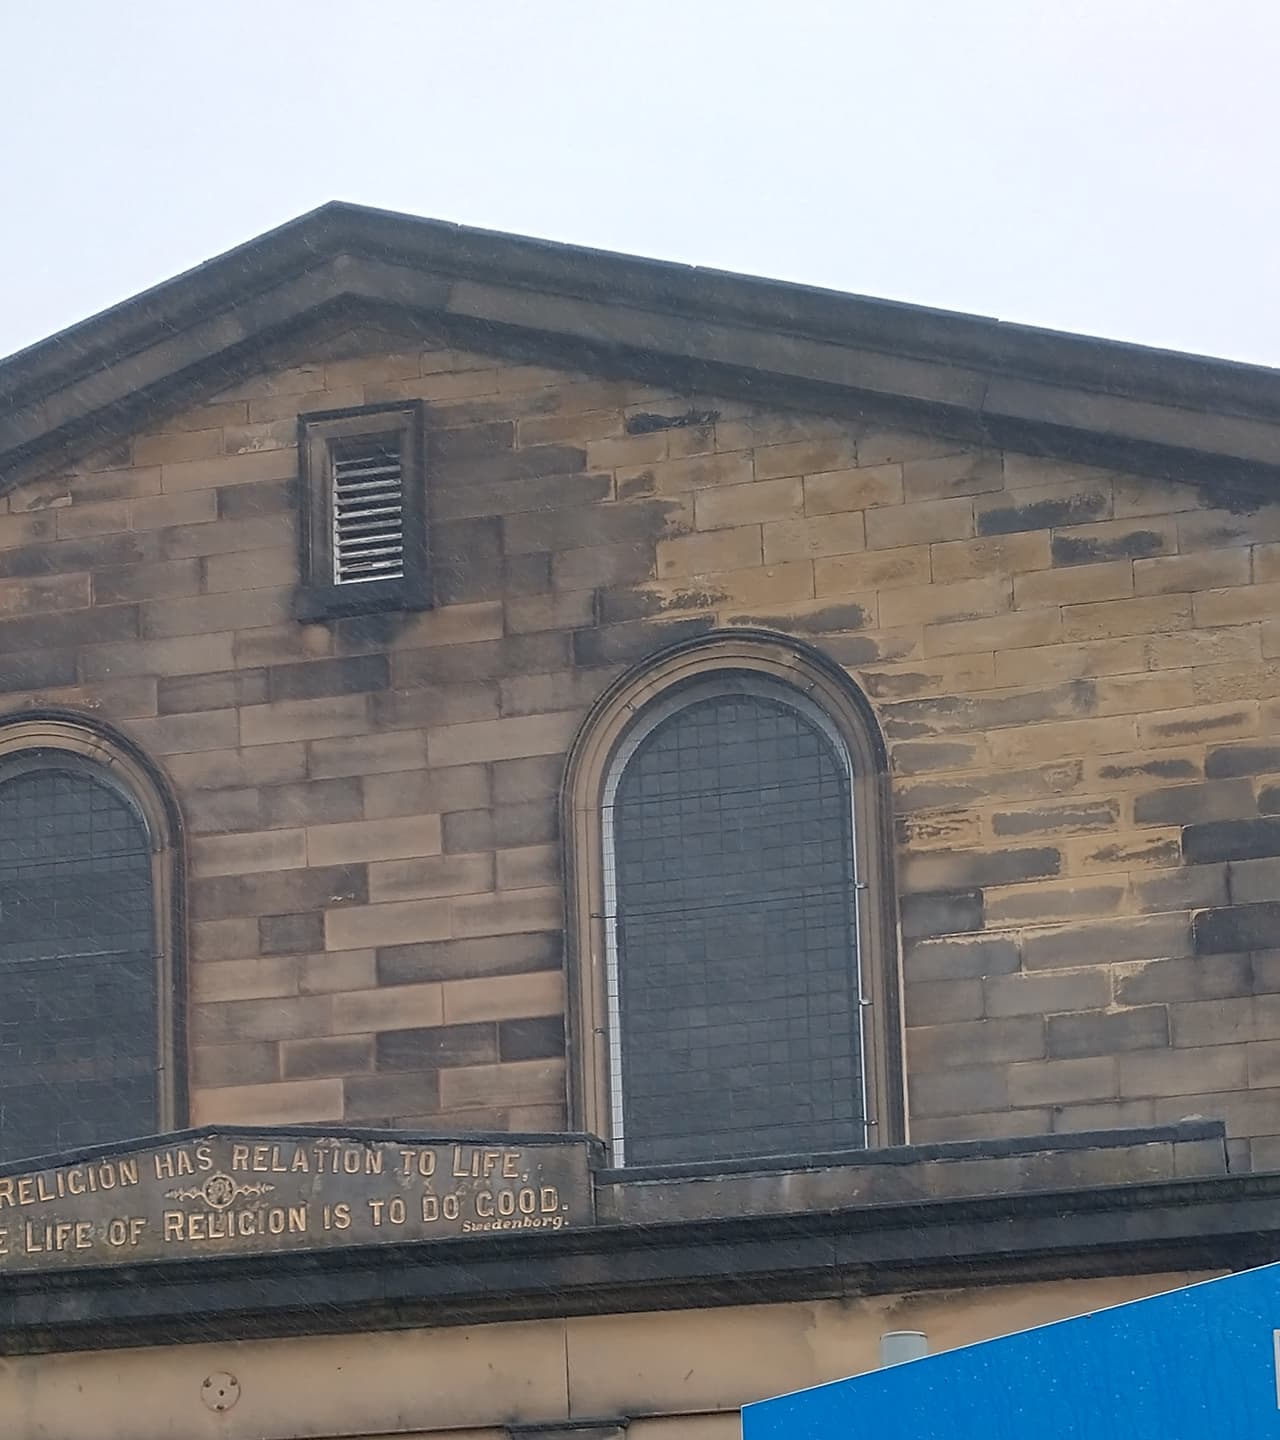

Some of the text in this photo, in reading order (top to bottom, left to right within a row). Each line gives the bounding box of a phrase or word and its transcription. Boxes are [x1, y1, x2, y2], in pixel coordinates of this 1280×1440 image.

[153, 1146, 214, 1180] HAS
[231, 1144, 384, 1175] RELATION
[400, 1150, 438, 1176] TO
[24, 1220, 93, 1253] LIFE
[108, 1217, 148, 1247] OF
[164, 1206, 308, 1243] RELIGION
[323, 1202, 353, 1230] IS
[370, 1198, 408, 1226] TO
[422, 1192, 461, 1222] DO
[474, 1187, 569, 1218] GOOD.
